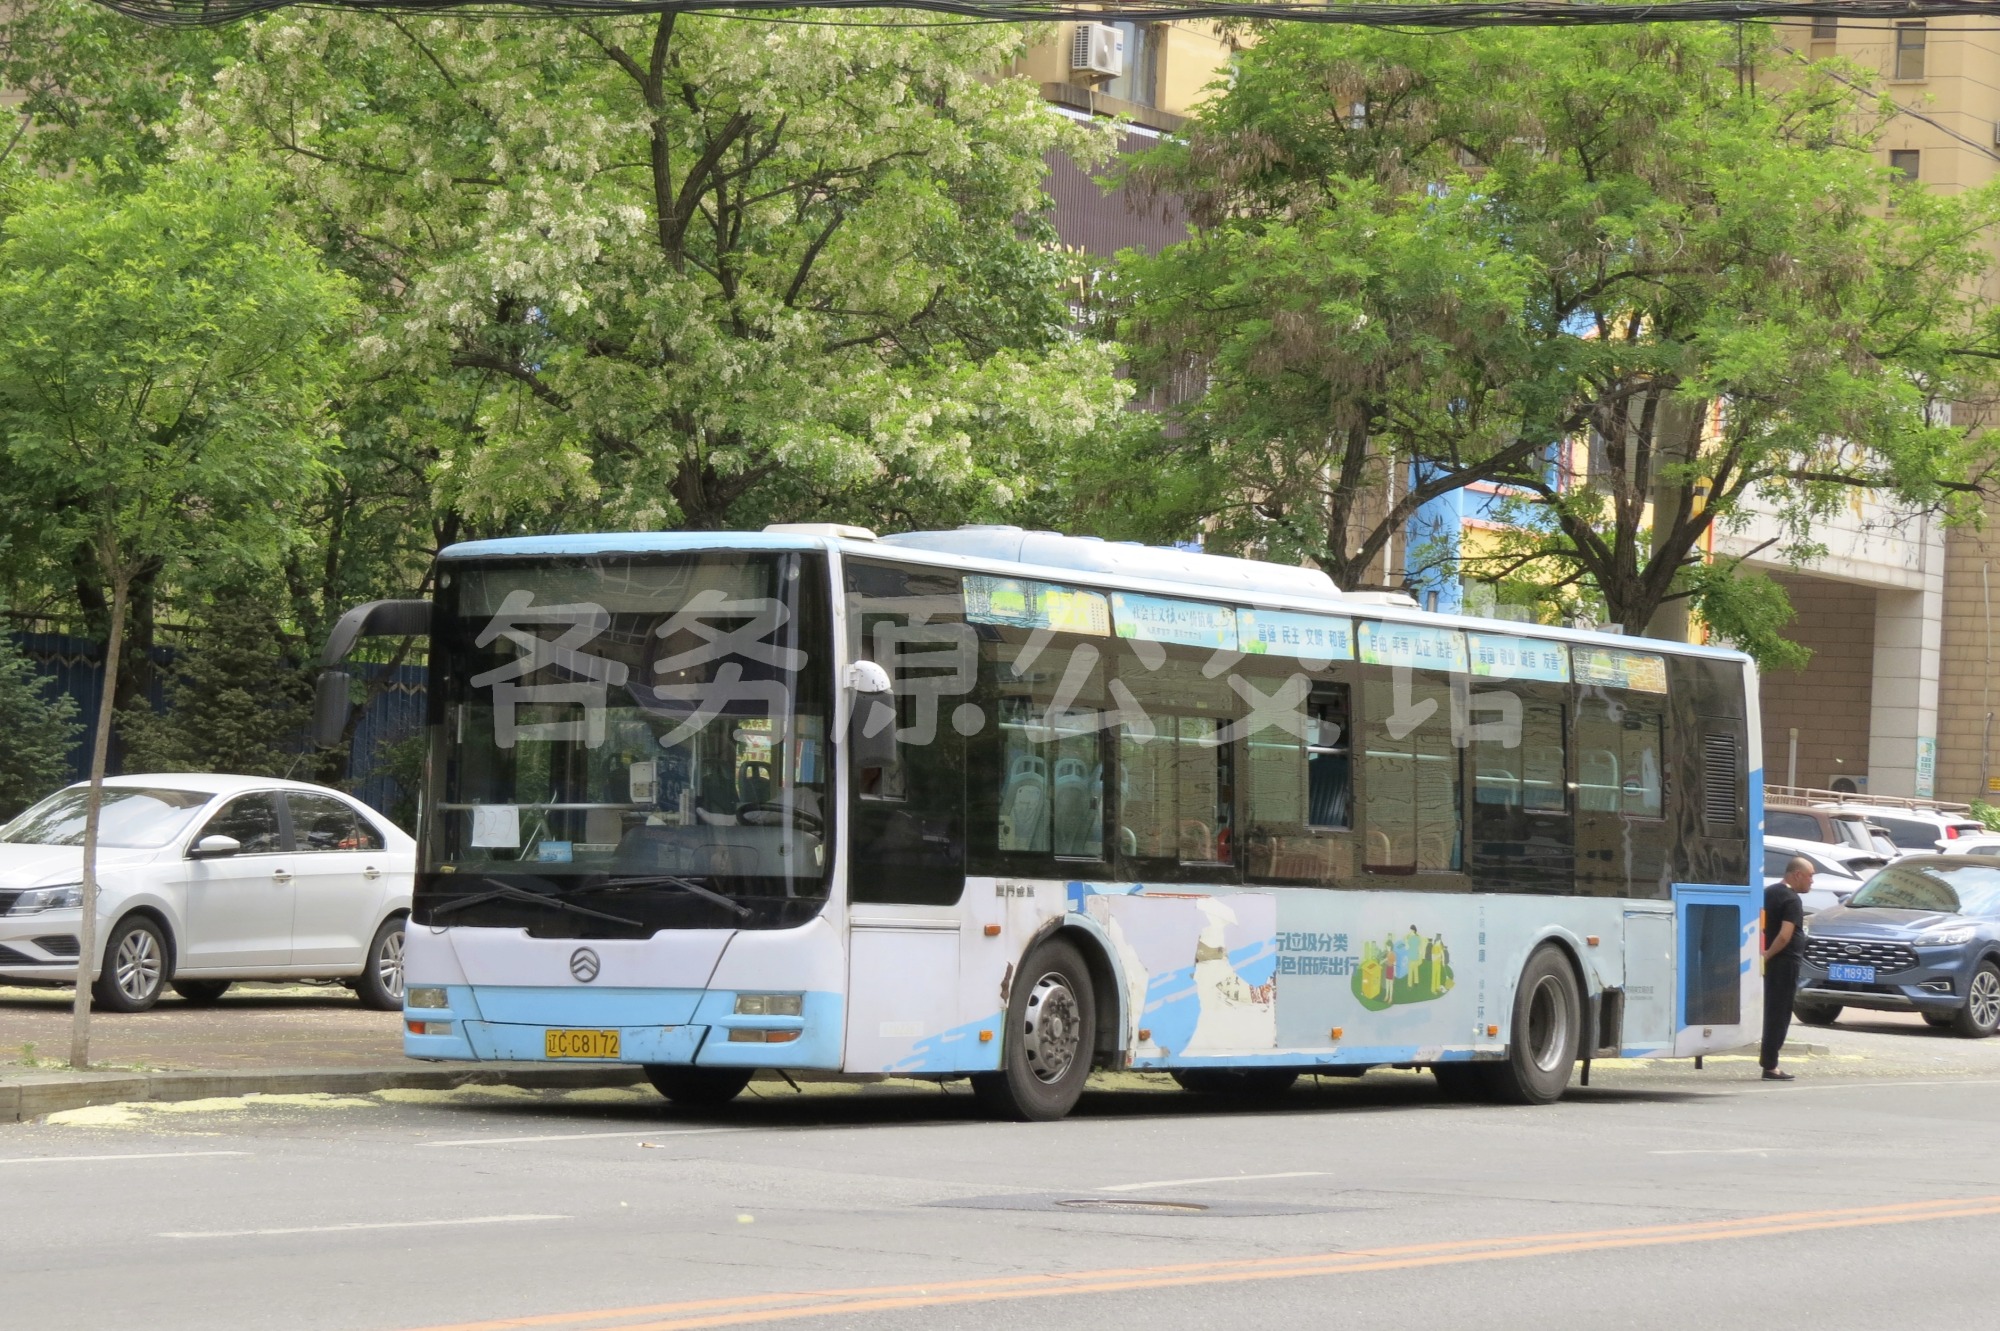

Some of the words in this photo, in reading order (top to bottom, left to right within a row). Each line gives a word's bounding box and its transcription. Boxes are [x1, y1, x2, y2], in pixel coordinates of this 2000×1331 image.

[1258, 623, 1276, 642] 富强
[1282, 625, 1300, 644] 民主
[1305, 628, 1323, 646] 文明
[1329, 630, 1347, 649] 和谐
[1370, 635, 1387, 652] 自由
[1392, 636, 1409, 654] 平等
[1414, 638, 1431, 657] 公正
[1436, 640, 1453, 659] 法治
[1479, 647, 1495, 664] 爱国
[1519, 650, 1536, 668] 诚信
[1542, 652, 1559, 670] 友善
[1276, 956, 1360, 976] 色低碳出行
